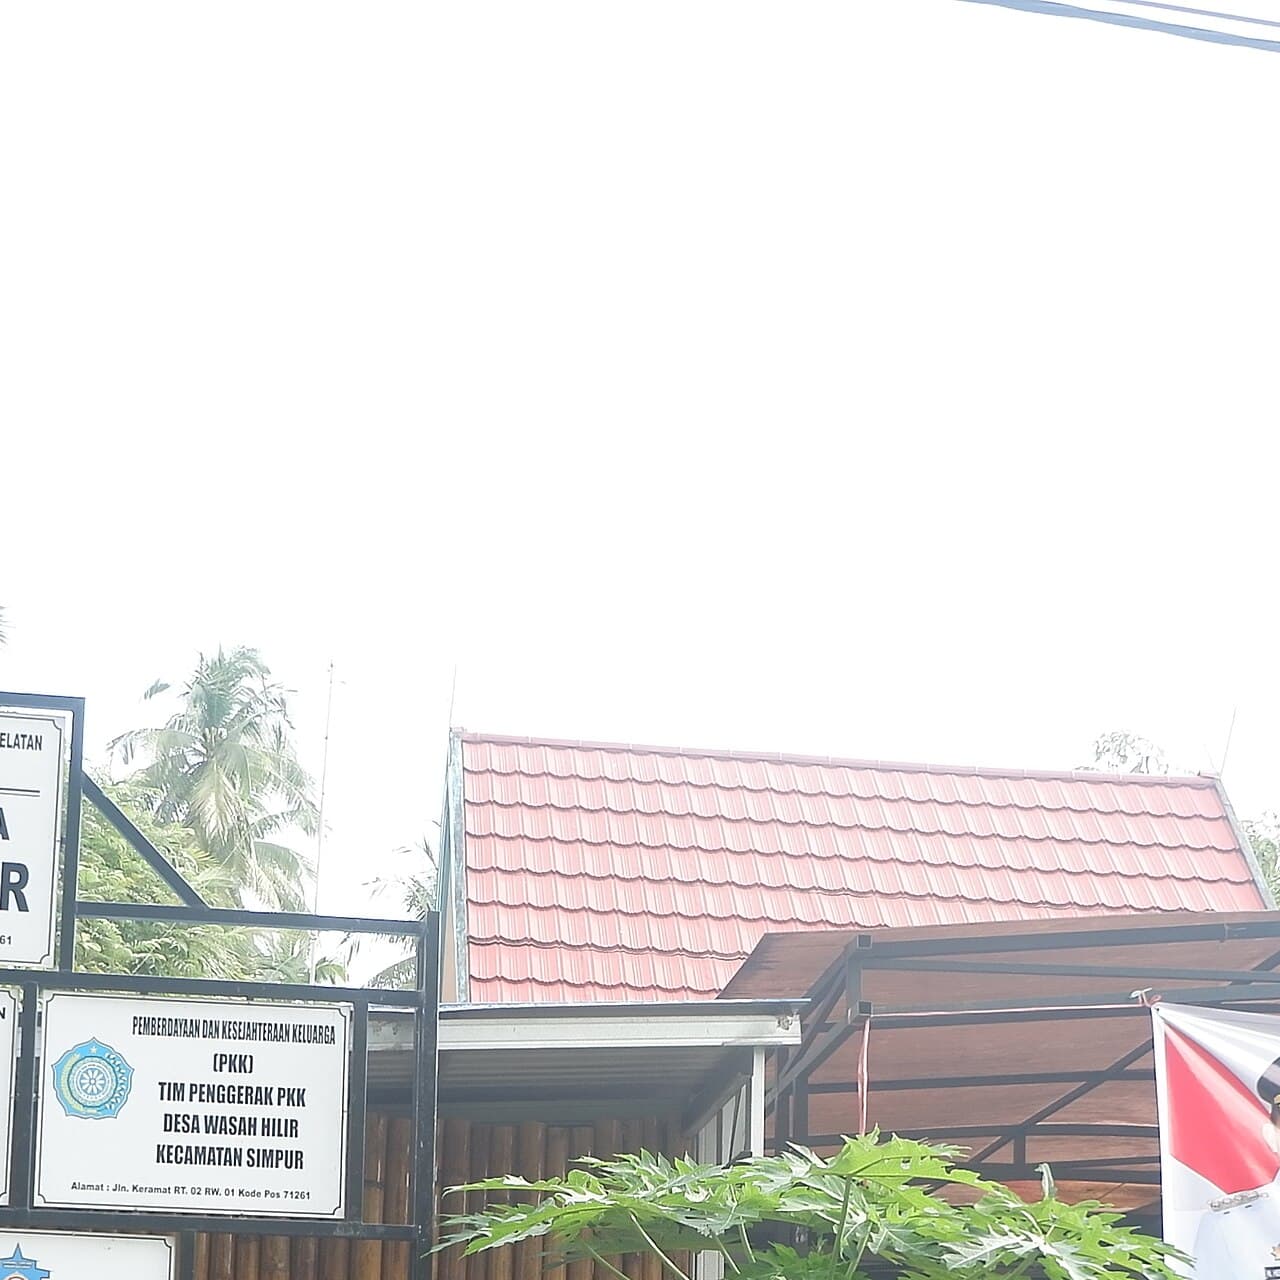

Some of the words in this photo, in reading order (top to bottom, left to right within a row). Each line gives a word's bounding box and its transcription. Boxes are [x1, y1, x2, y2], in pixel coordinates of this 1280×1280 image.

[132, 1015, 201, 1039] PEMBERDAYAAN
[202, 1019, 220, 1040] DAN
[221, 1020, 291, 1043] KESEJAHTERAAN
[292, 1023, 336, 1045] KELUARGA
[213, 1053, 254, 1074] (PKK)
[157, 1081, 186, 1102] TIM
[188, 1082, 274, 1106] PENGGERAK
[276, 1087, 306, 1108] PKK
[163, 1113, 201, 1134] DESA
[203, 1114, 258, 1137] WASAH
[261, 1117, 299, 1139] HILIR
[155, 1143, 243, 1168] KECAMATAN
[246, 1147, 304, 1170] SIMPUR
[70, 1181, 104, 1192] Alamat
[111, 1183, 130, 1193] Jln.
[131, 1184, 172, 1195] Keramat
[173, 1185, 188, 1195] RT.
[190, 1186, 202, 1196] 02
[204, 1187, 222, 1197] RW.
[224, 1187, 235, 1197] 01
[238, 1188, 262, 1198] Kode
[264, 1189, 281, 1199] Pos
[283, 1190, 310, 1201] 71261
